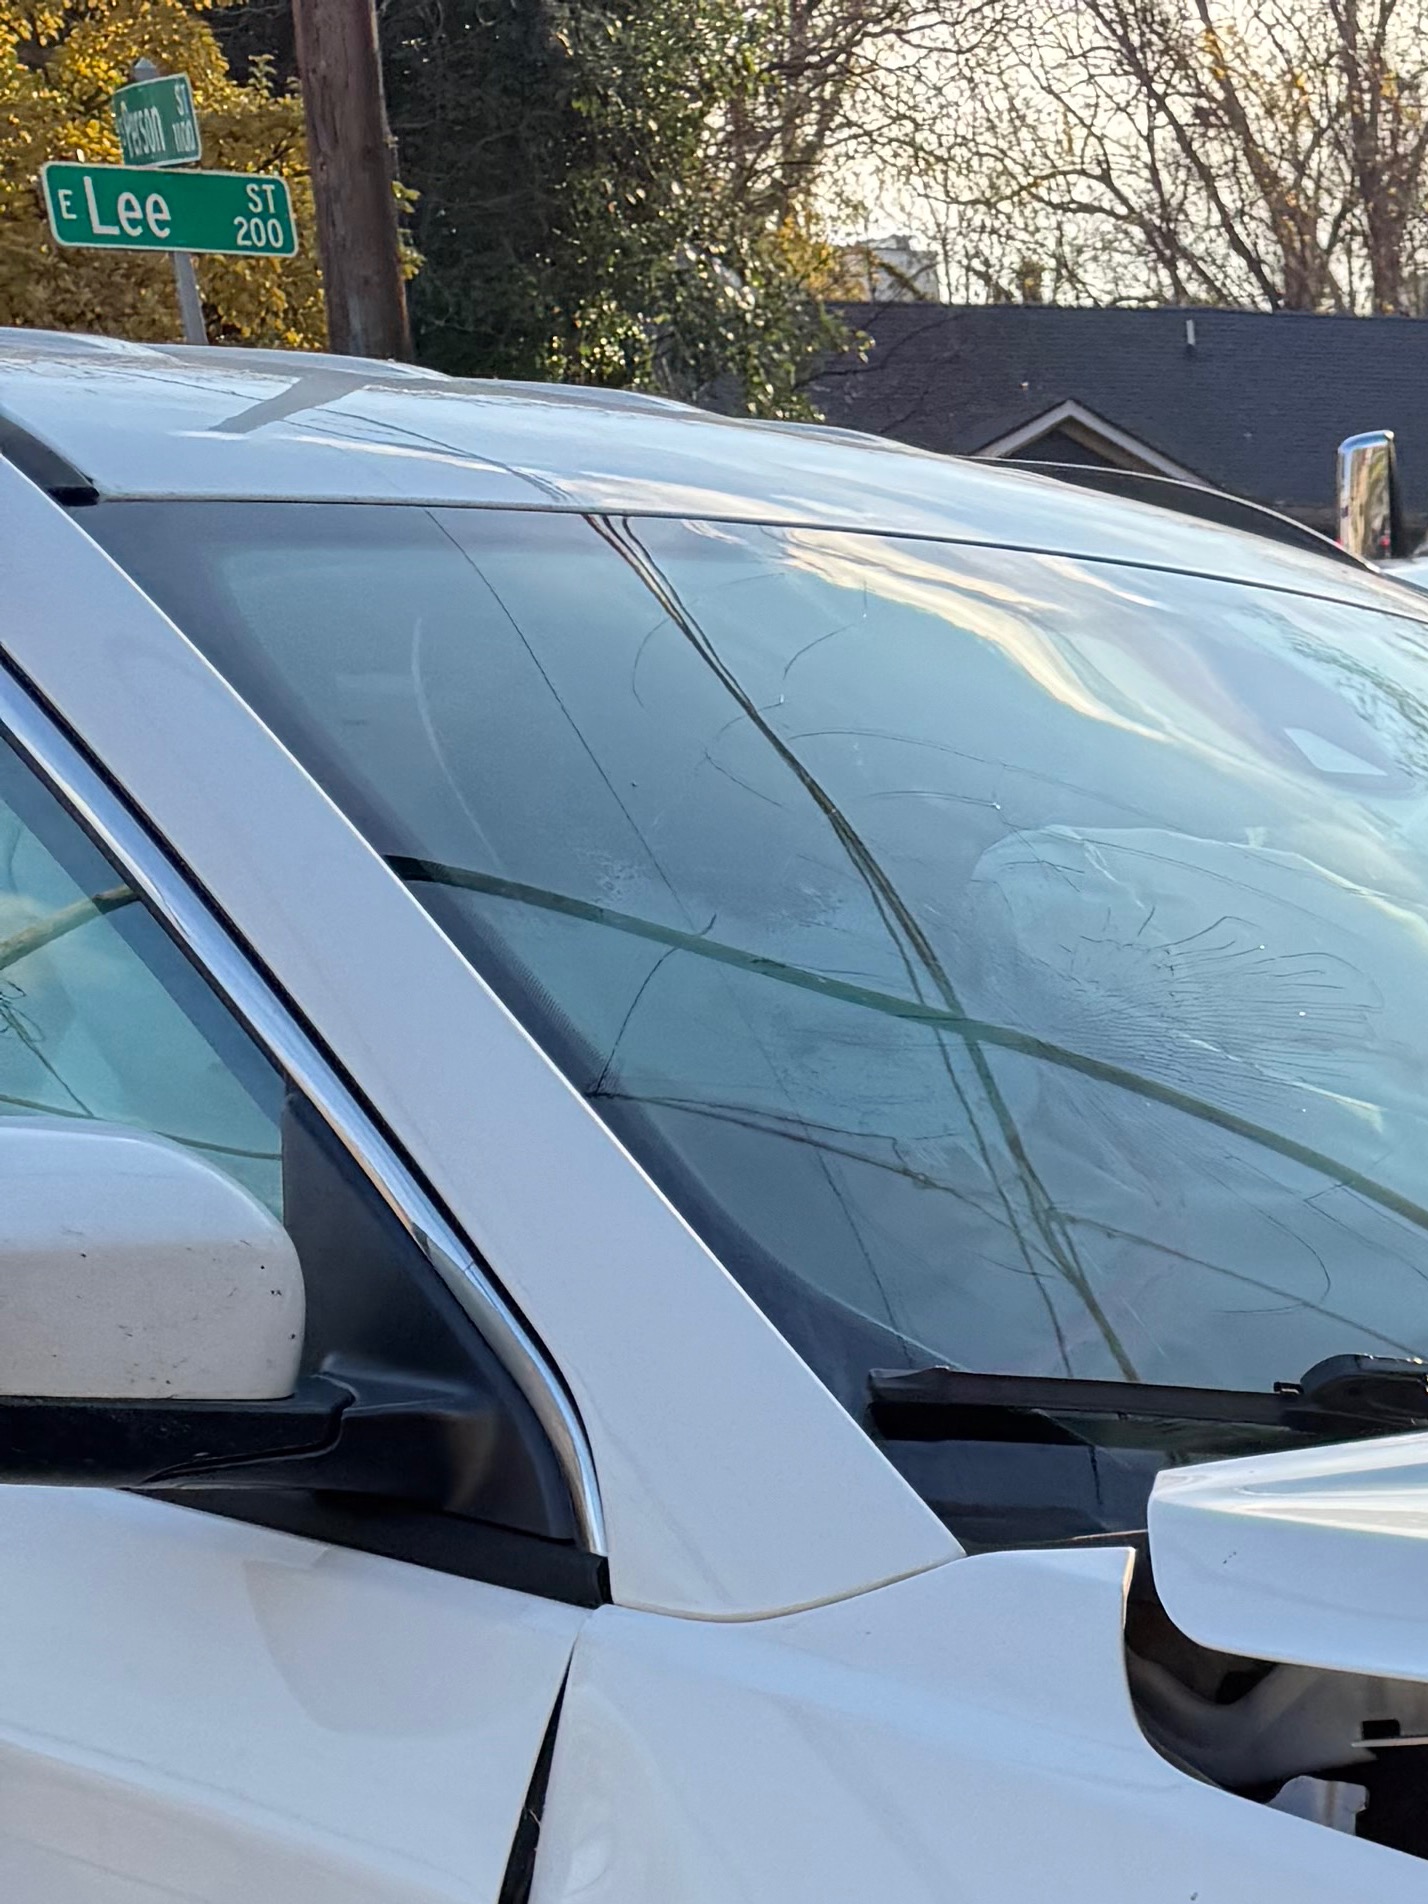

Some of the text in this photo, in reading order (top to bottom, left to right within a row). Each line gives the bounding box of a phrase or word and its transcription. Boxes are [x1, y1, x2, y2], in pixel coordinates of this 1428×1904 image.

[58, 175, 172, 239] E Lee
[246, 183, 276, 215] ST
[233, 217, 285, 249] 200
